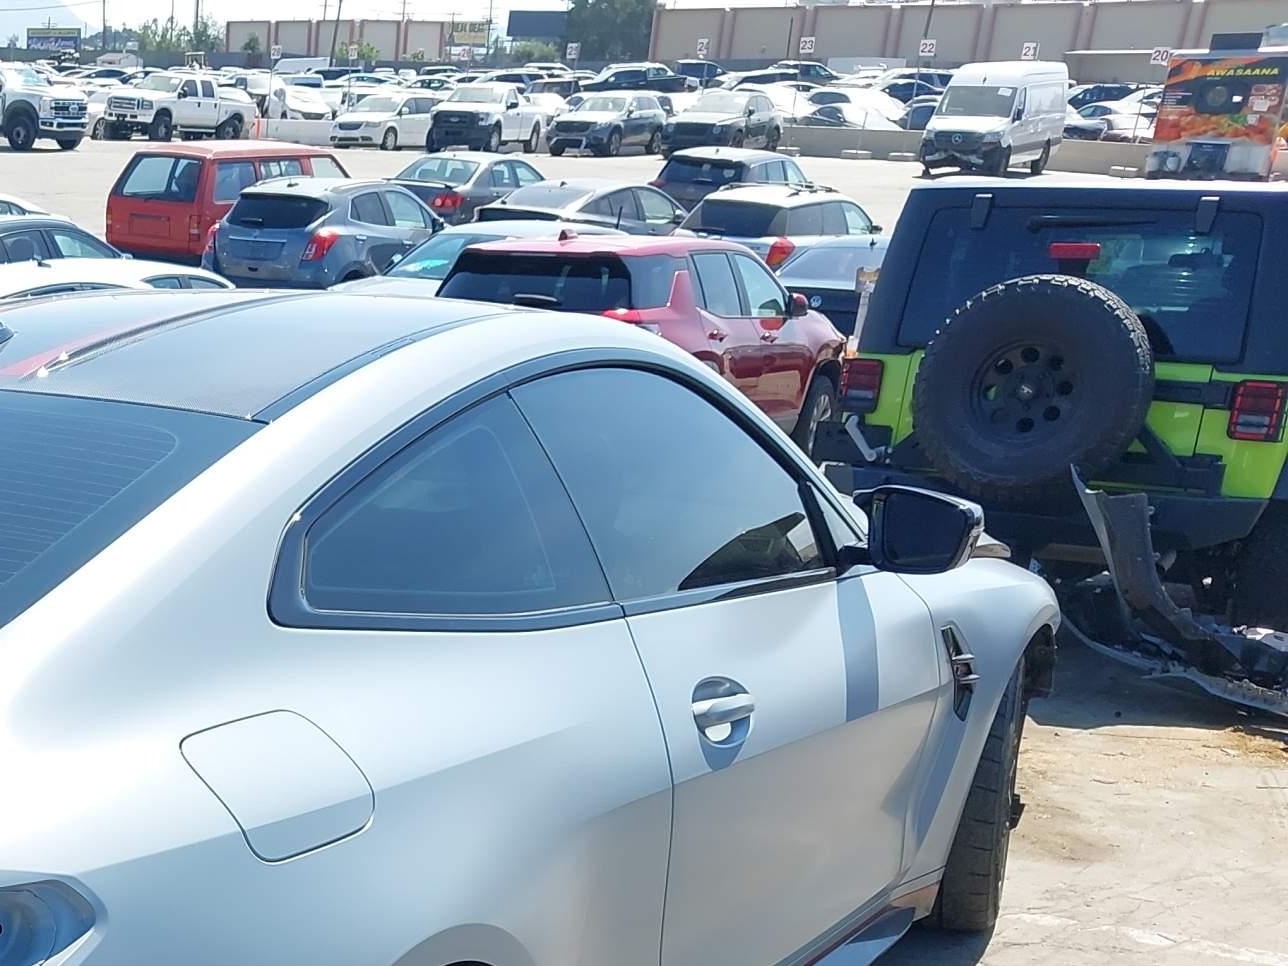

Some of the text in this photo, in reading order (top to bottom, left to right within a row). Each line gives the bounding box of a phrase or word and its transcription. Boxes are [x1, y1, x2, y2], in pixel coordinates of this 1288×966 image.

[800, 39, 814, 50] 23
[920, 42, 935, 53] 22
[1022, 45, 1037, 57] 21
[1152, 49, 1170, 62] 20
